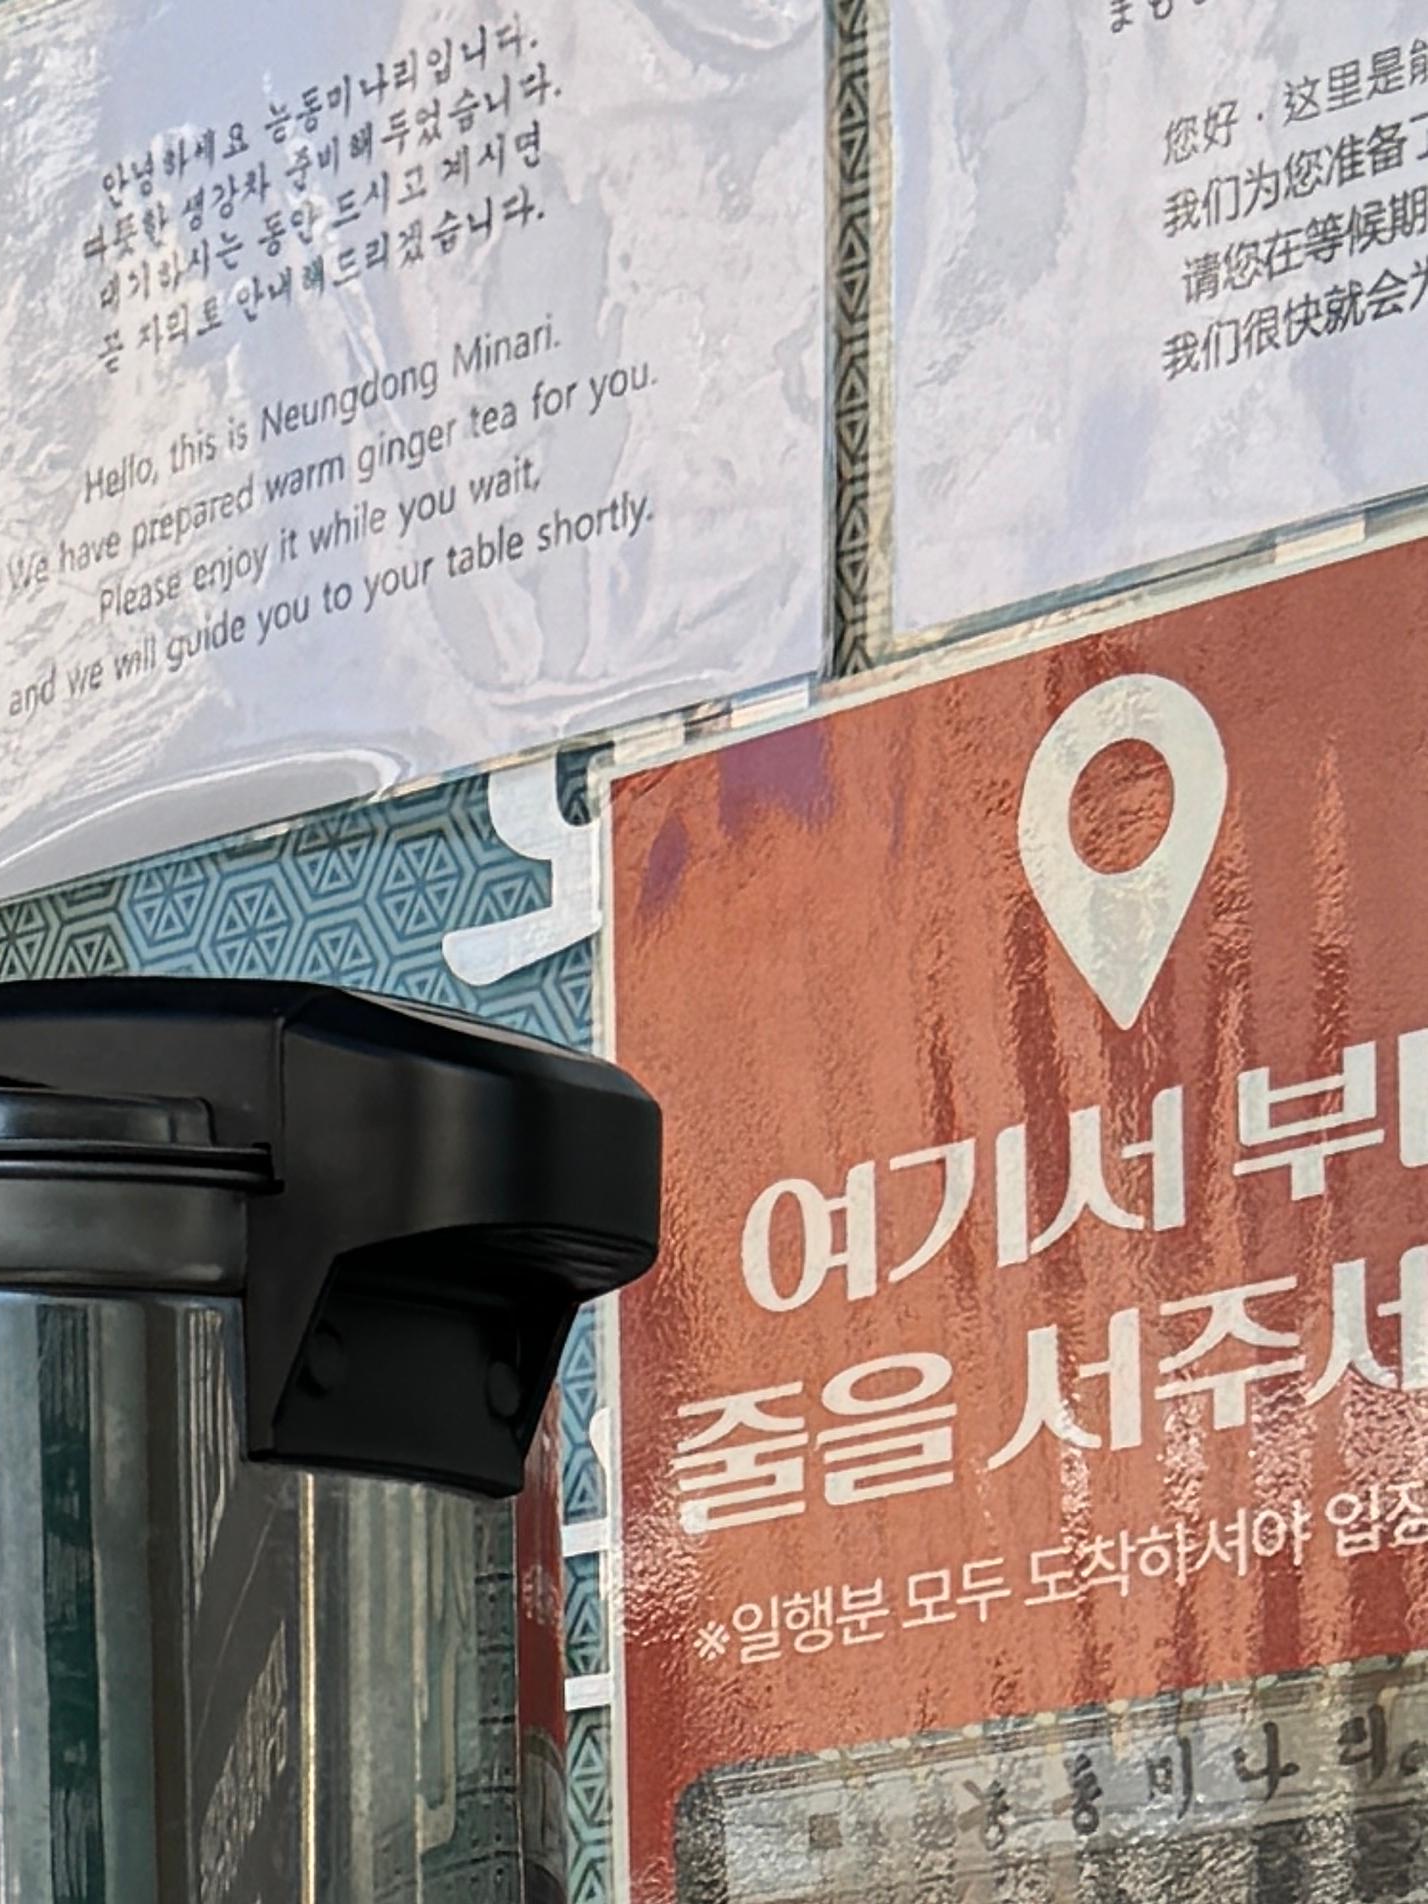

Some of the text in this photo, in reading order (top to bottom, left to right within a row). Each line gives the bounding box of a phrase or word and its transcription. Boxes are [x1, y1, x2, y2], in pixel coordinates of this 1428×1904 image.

[102, 13, 539, 208] 안녕하세요 능동미나리입니다.
[83, 199, 168, 263] 따뜻한
[181, 161, 272, 232] 생강차
[98, 121, 544, 309] 대기하시는 동안 드시고 계시면
[84, 312, 561, 502] Hello, this is Neungdong Minari.
[137, 294, 224, 355] 자리로
[5, 357, 658, 593] We have prepared warm ginger tea for you.
[97, 453, 542, 624] Please enjoy it while you wait,
[8, 489, 655, 719] and we will guide you to your table shortly.
[741, 1031, 1428, 1313] 여기서 부
[670, 1353, 957, 1536] 줄을
[901, 1556, 1012, 1630] 모두
[1024, 1499, 1312, 1608] 도착하셔야
